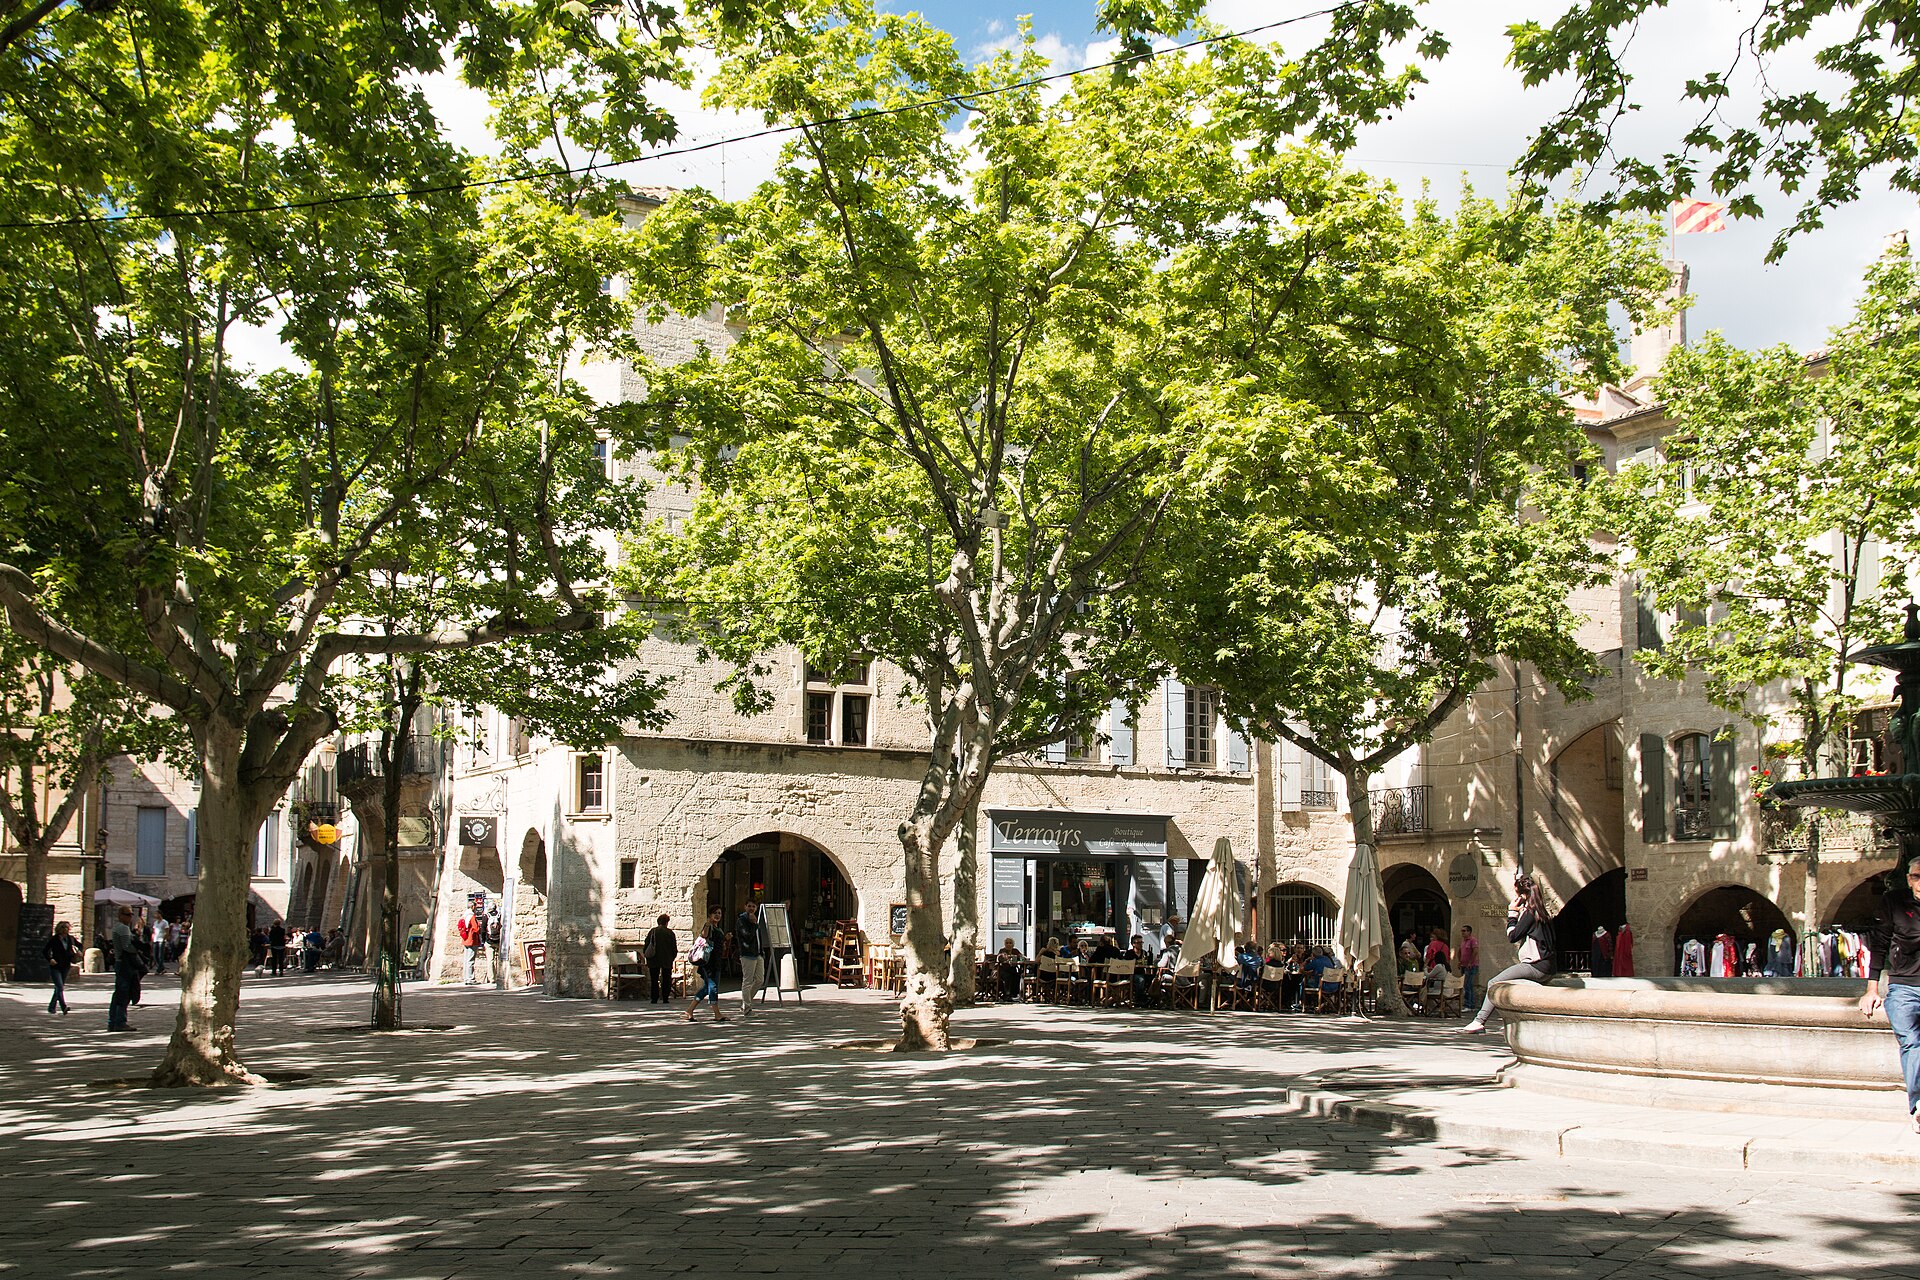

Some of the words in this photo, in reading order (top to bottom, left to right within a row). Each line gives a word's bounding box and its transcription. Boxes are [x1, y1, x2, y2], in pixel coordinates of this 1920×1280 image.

[997, 819, 1081, 847] Terroirs
[1113, 827, 1144, 838] Boutique
[1120, 839, 1158, 848] Restaurant
